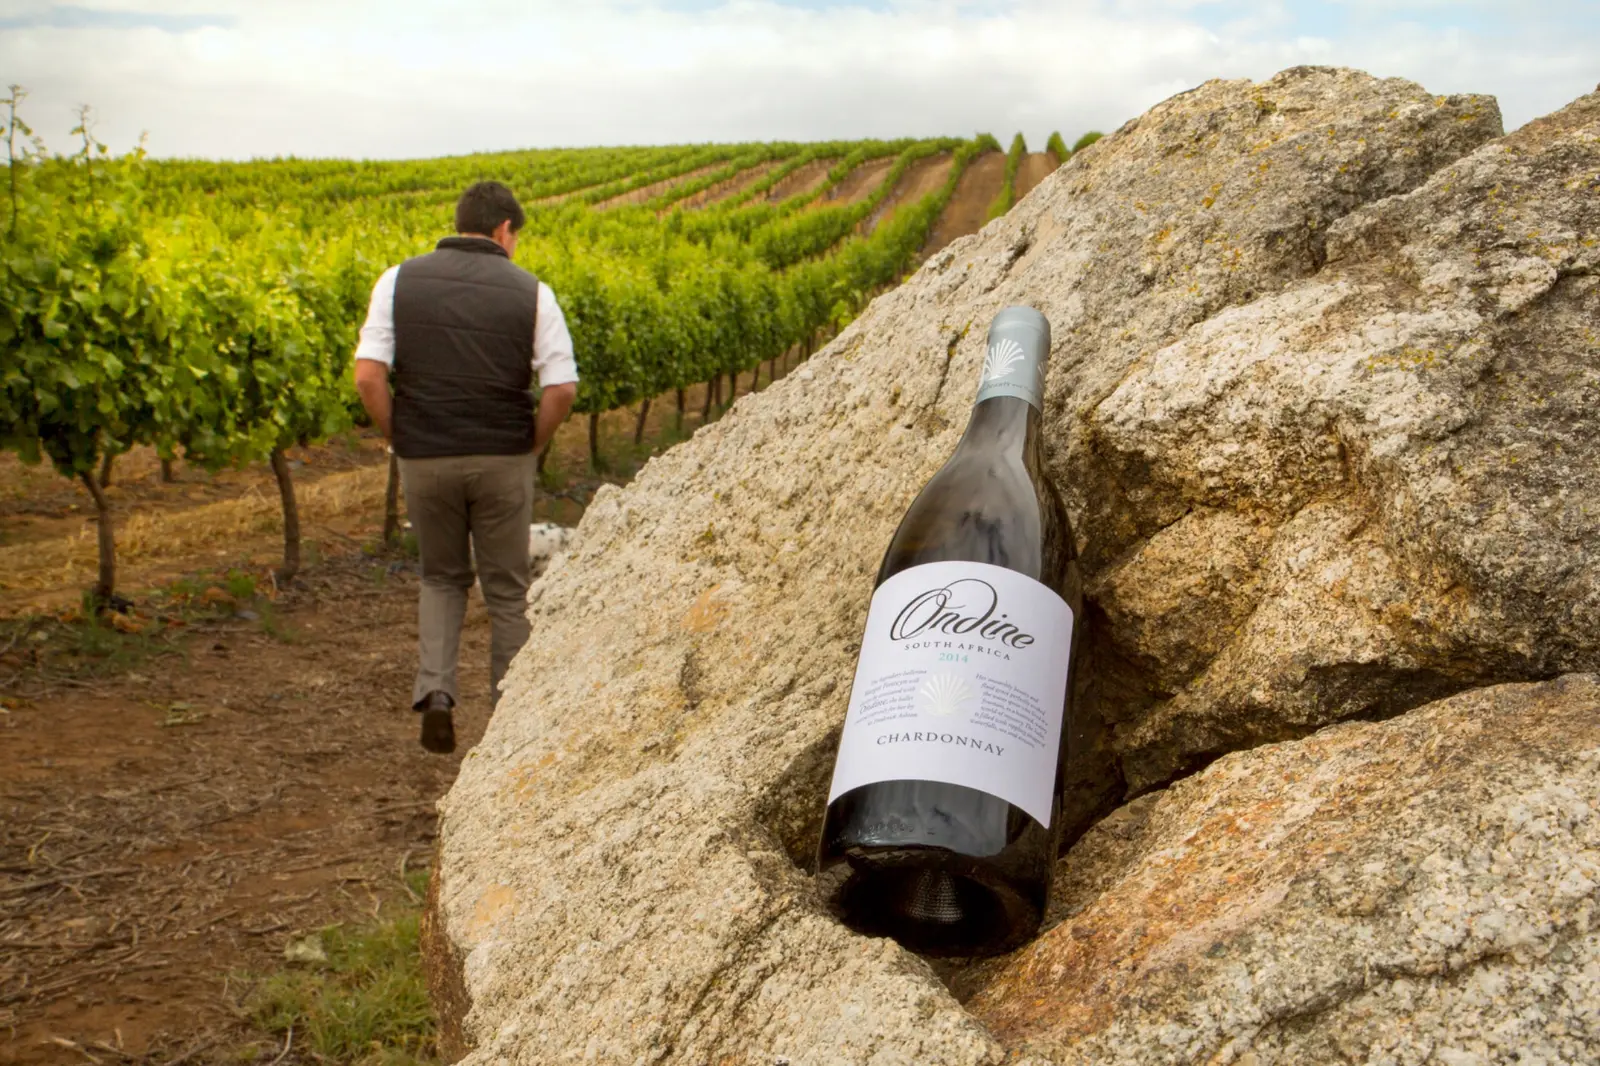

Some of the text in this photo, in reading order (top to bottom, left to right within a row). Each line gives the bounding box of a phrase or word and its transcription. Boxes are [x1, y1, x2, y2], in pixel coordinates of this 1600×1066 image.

[890, 578, 1035, 649] Ondine
[904, 641, 1011, 661] SOUTH AFRICA
[938, 652, 969, 663] 2014
[877, 732, 1004, 756] CHARDONNAY
